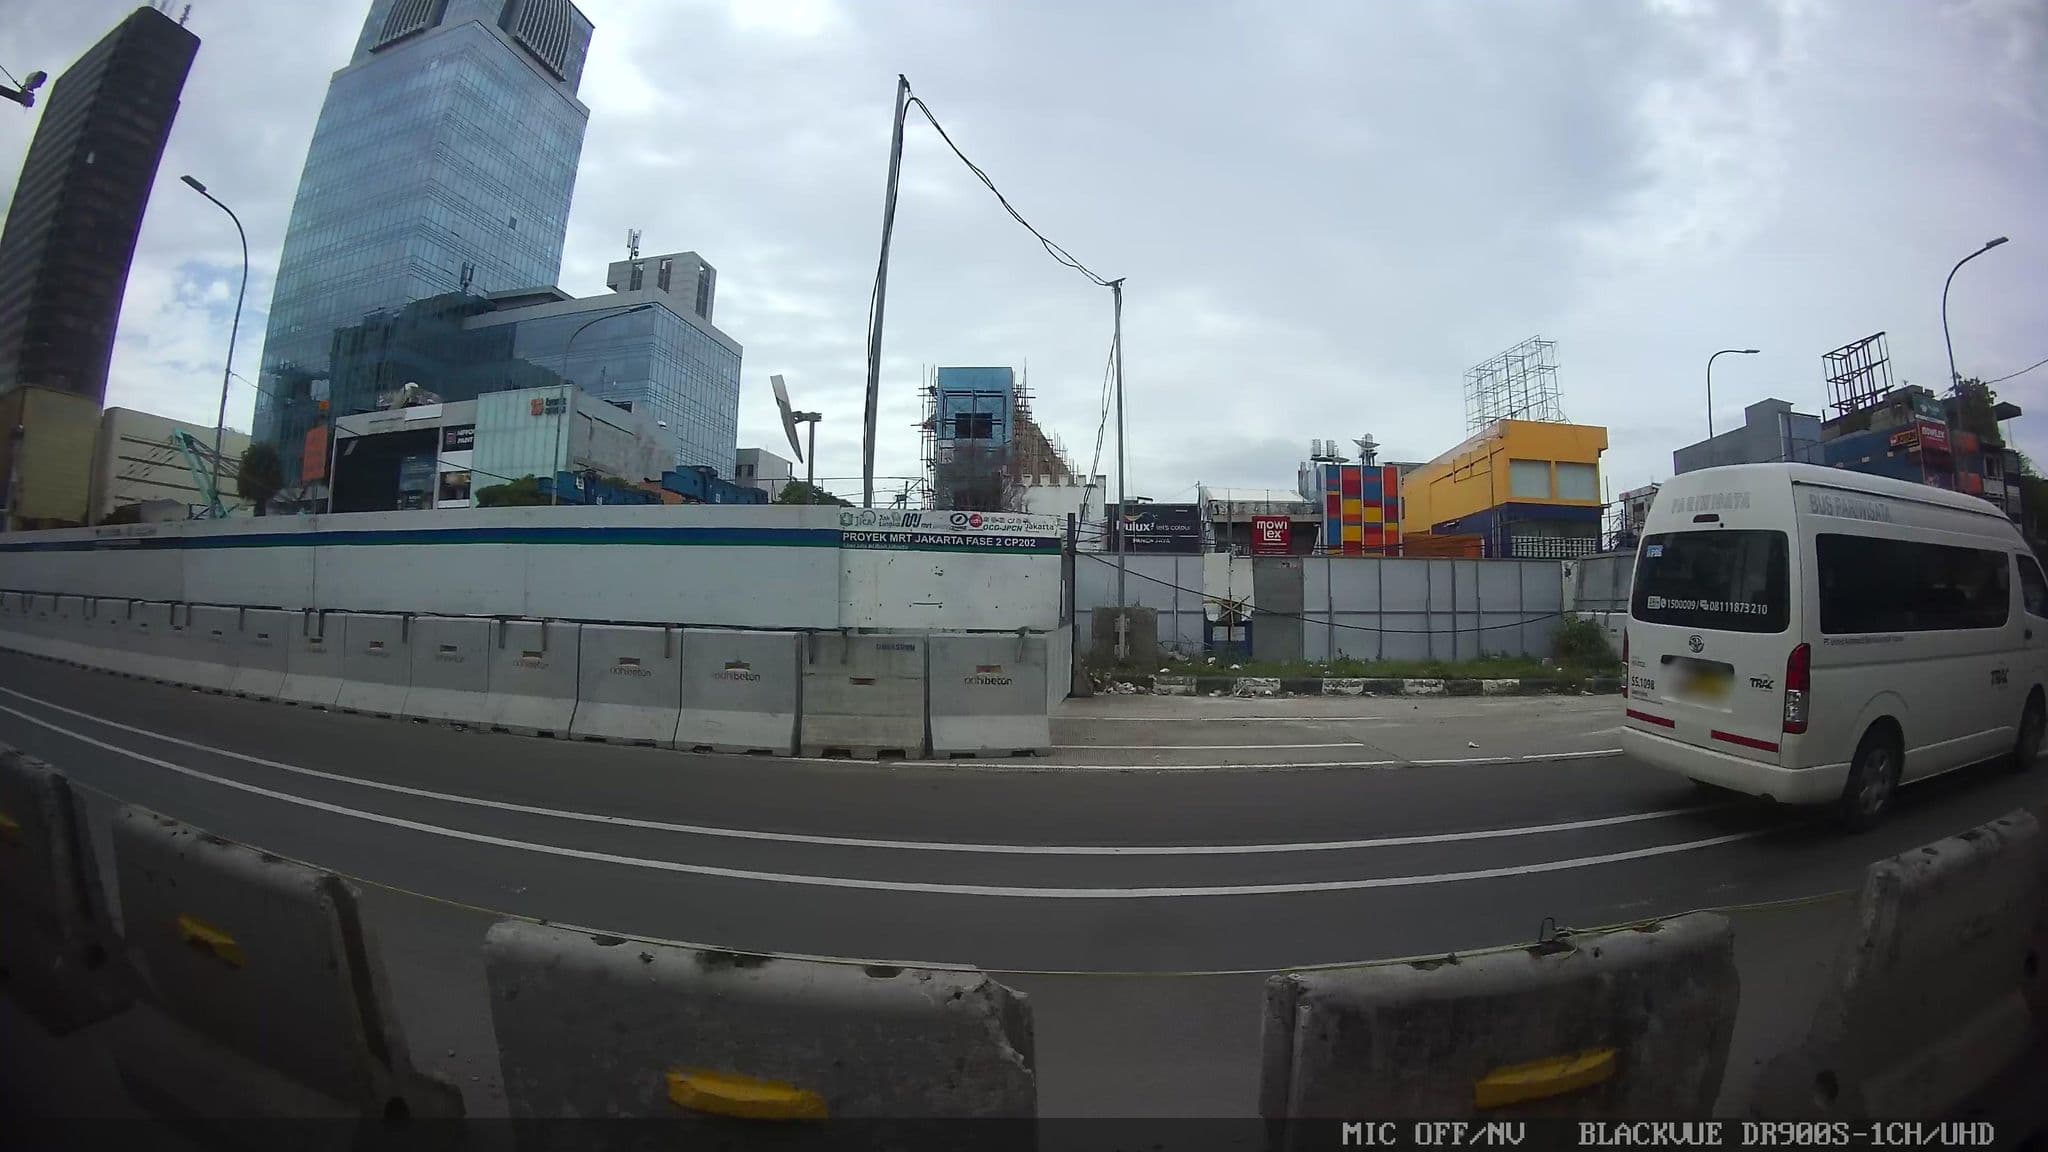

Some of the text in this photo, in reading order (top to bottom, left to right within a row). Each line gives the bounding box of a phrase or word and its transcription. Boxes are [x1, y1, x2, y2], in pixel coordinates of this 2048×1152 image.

[1808, 493, 1833, 514] BUS
[842, 532, 888, 542] PROYEK
[889, 533, 913, 543] MRT
[914, 535, 964, 546] JAKARTA
[966, 536, 994, 546] FASE
[995, 537, 1002, 546] 2
[1004, 537, 1037, 547] CP202
